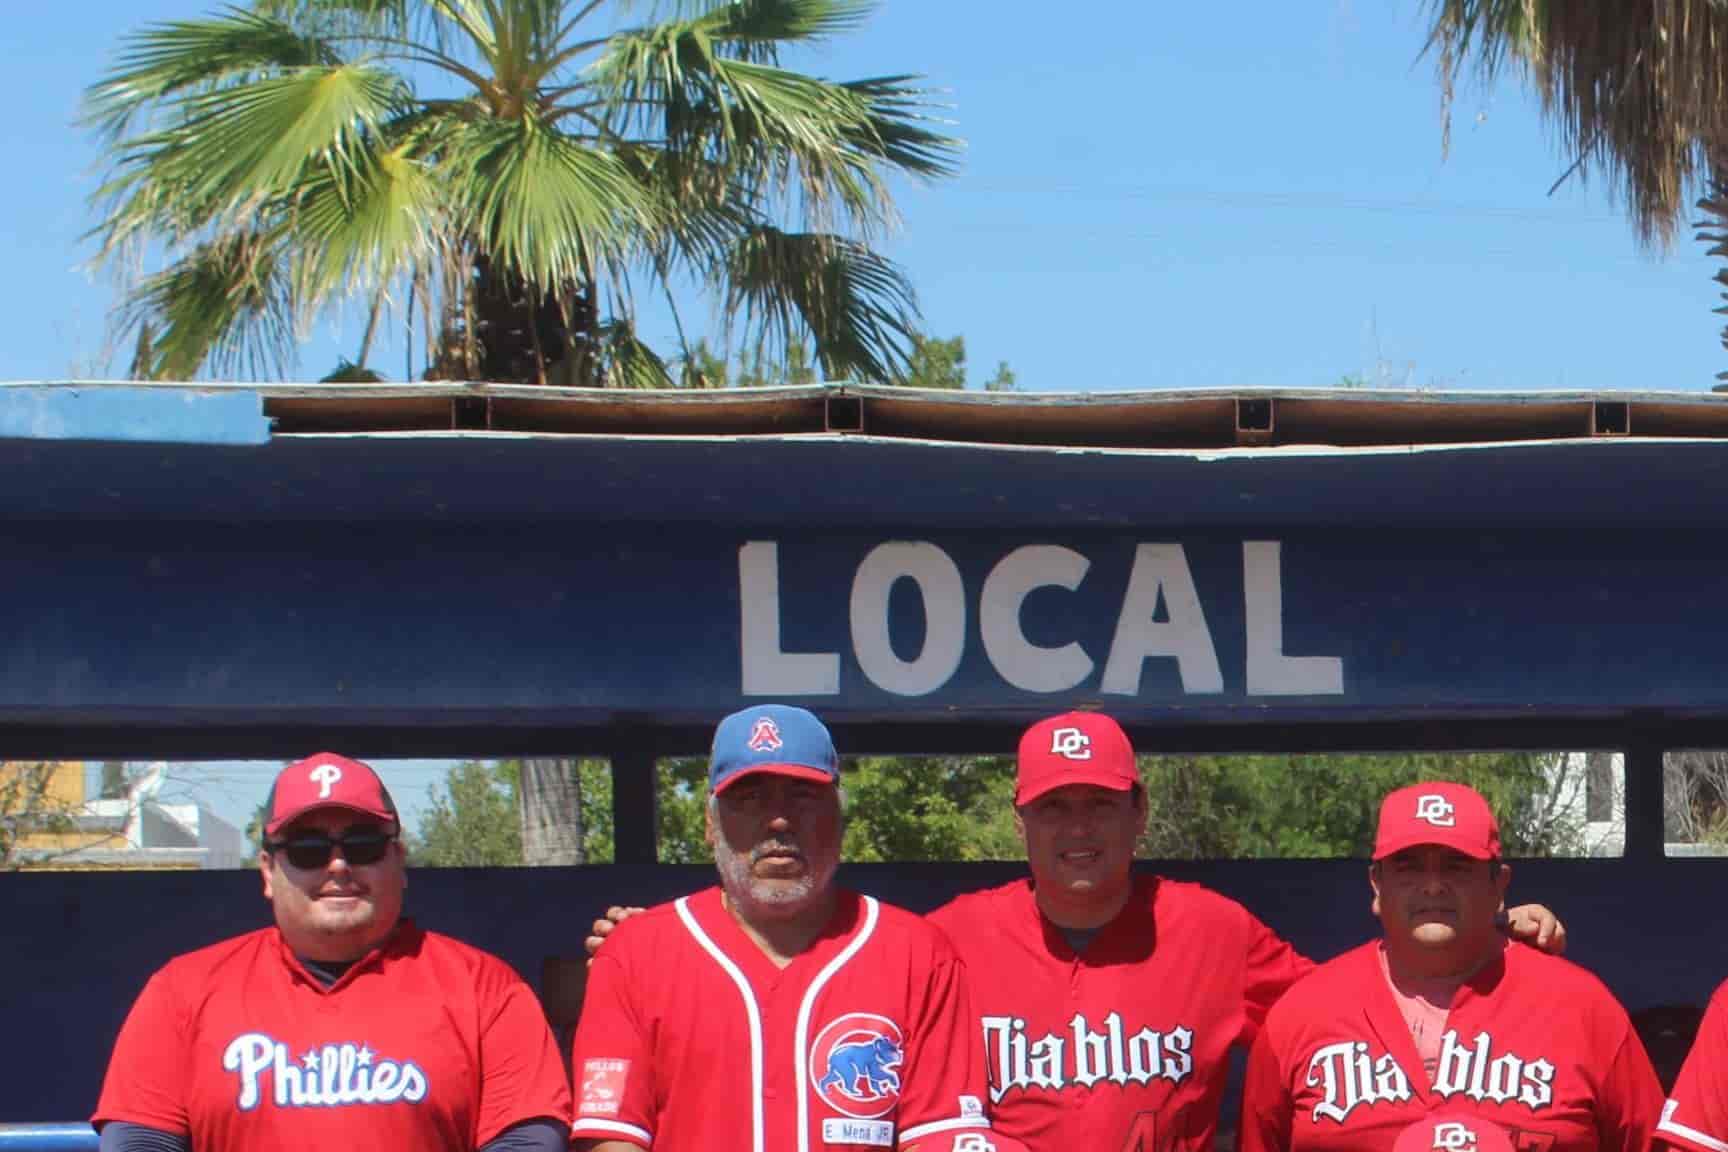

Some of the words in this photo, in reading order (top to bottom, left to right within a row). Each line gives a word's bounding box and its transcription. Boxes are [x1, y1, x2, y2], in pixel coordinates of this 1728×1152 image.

[738, 540, 1344, 696] LOCAL
[749, 716, 783, 752] A
[1051, 728, 1091, 760] DC
[310, 765, 342, 799] P
[1416, 794, 1455, 826] DC
[223, 1033, 428, 1111] Phillies
[980, 1011, 1194, 1105] Diablos
[1304, 1028, 1557, 1124] Diablos
